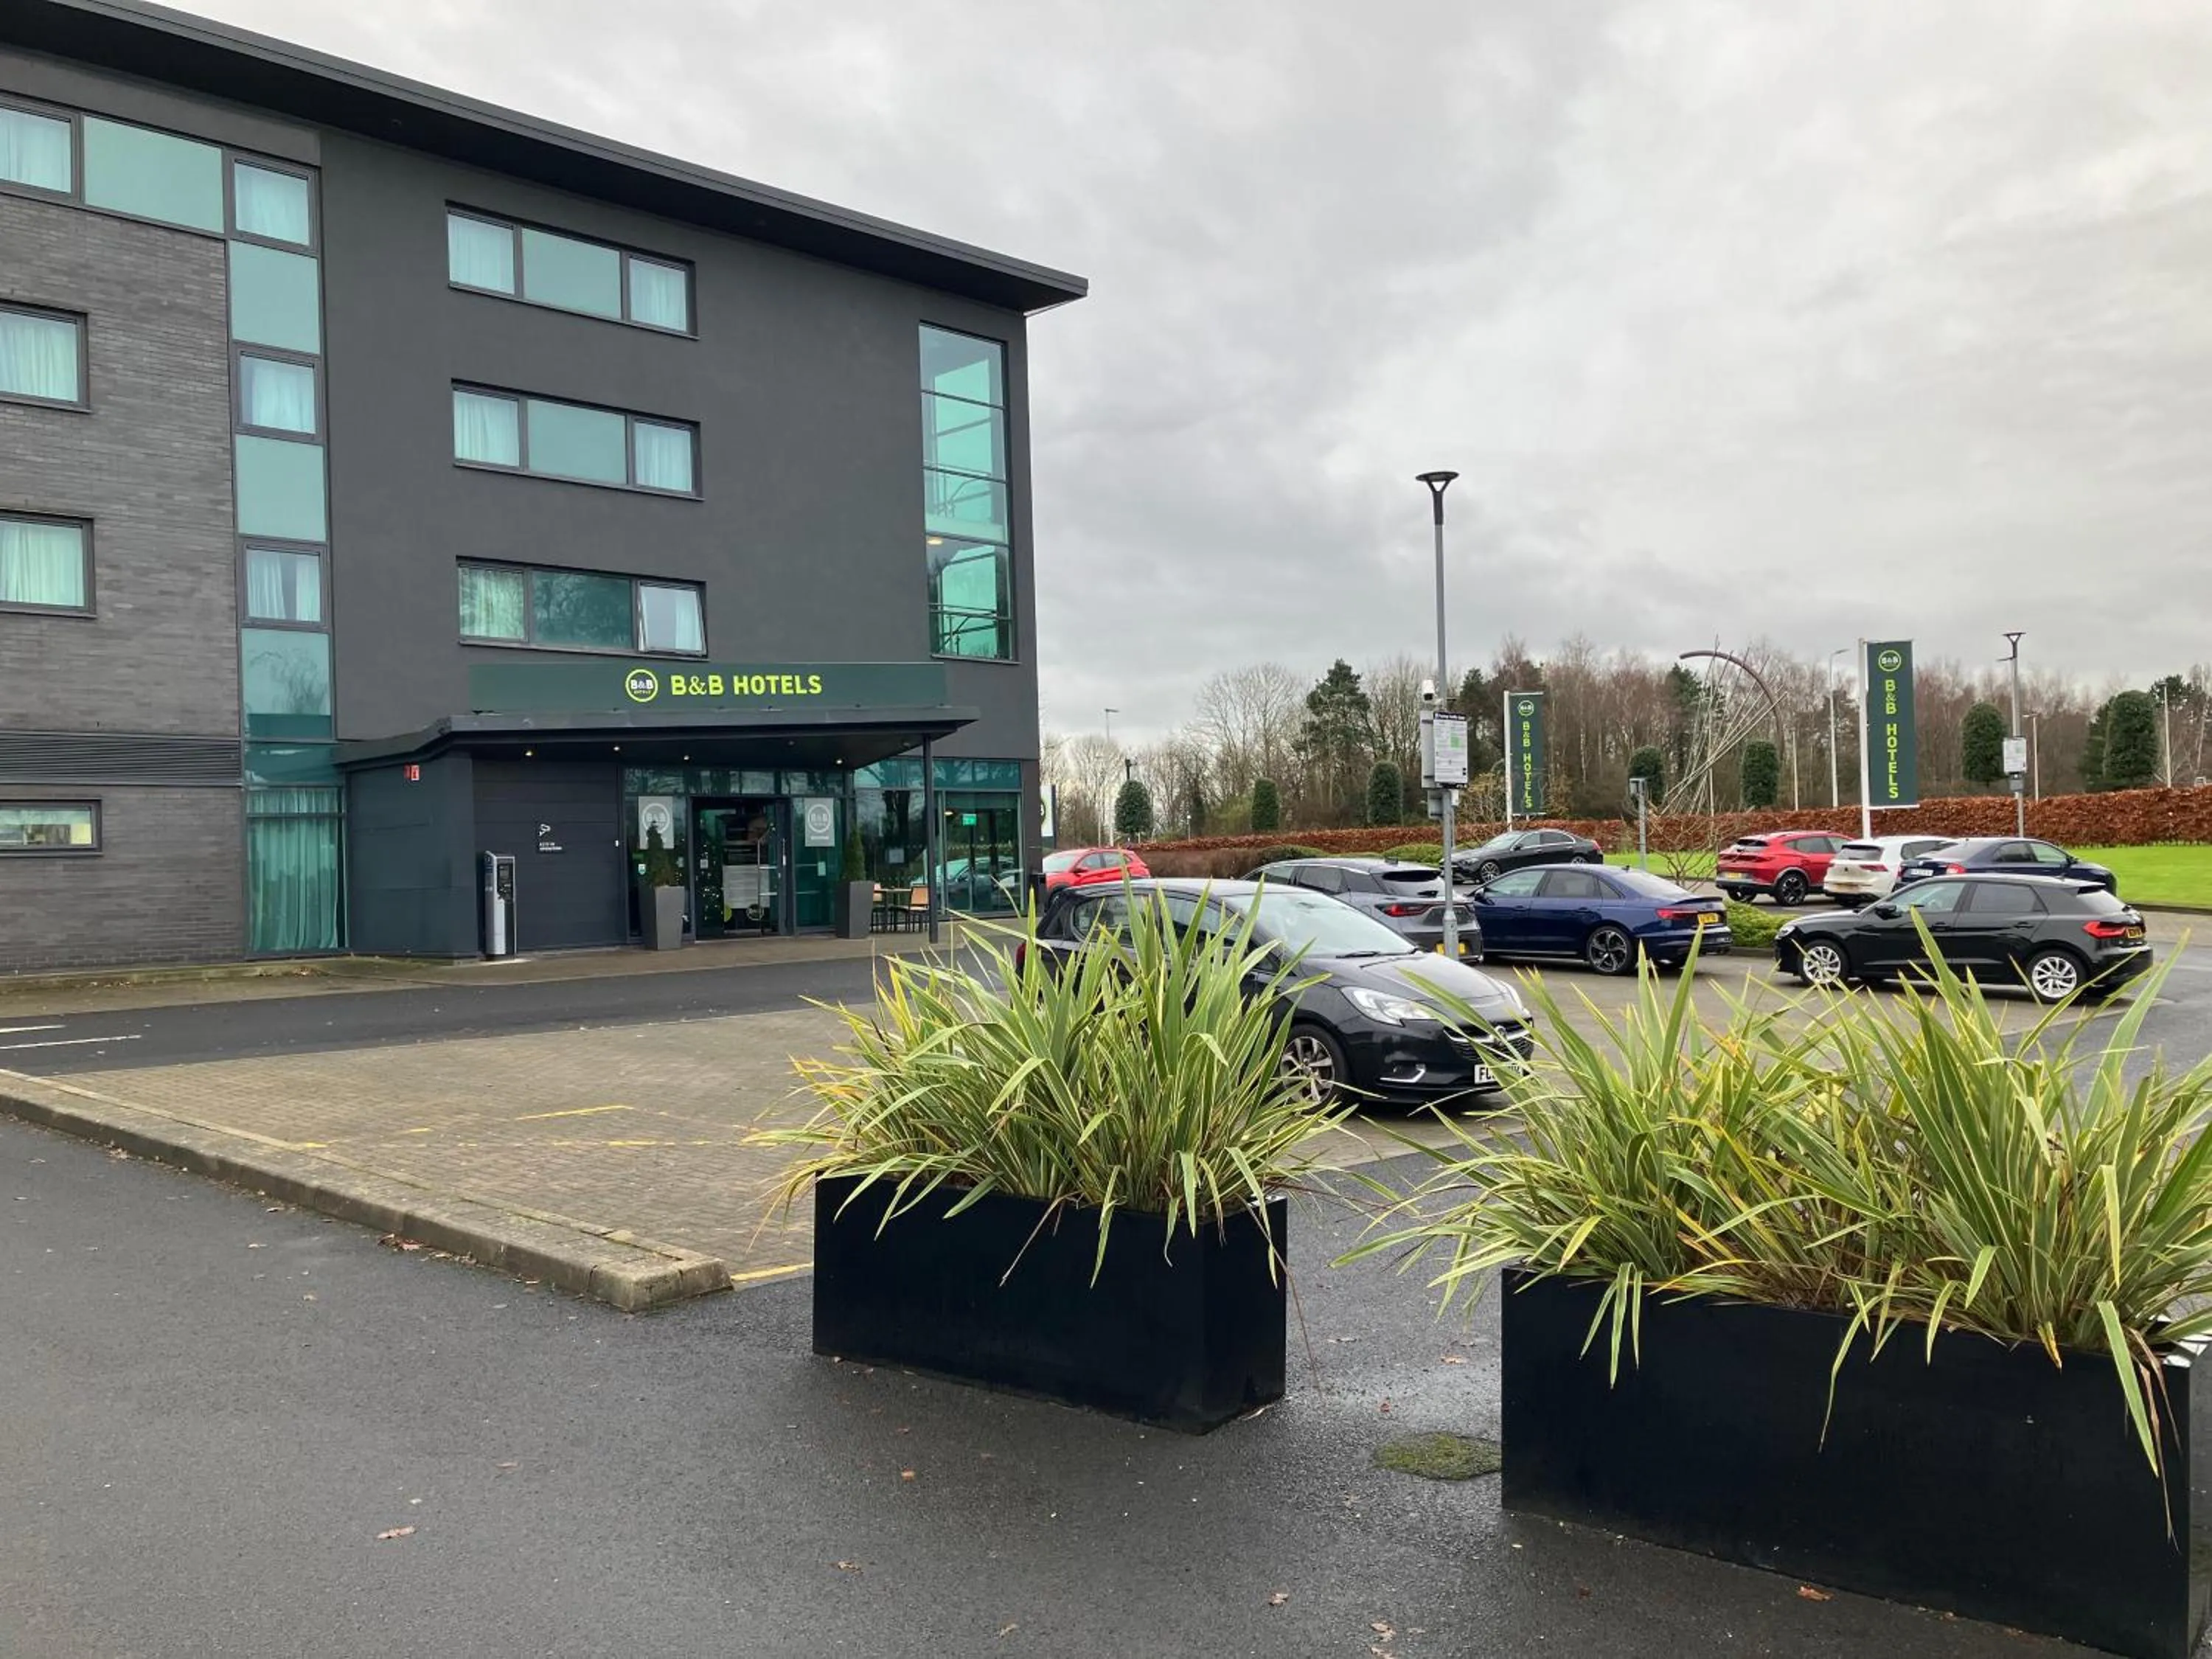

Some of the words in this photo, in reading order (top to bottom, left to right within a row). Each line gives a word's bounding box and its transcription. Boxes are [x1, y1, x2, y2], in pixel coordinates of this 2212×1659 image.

[630, 679, 654, 689] B&B
[670, 675, 723, 695] B&B
[733, 675, 822, 695] HOTELS
[1885, 679, 1897, 714] B&B
[1523, 721, 1531, 747] B&B
[1886, 723, 1899, 799] HOTELS
[1523, 753, 1533, 808] HOTELS
